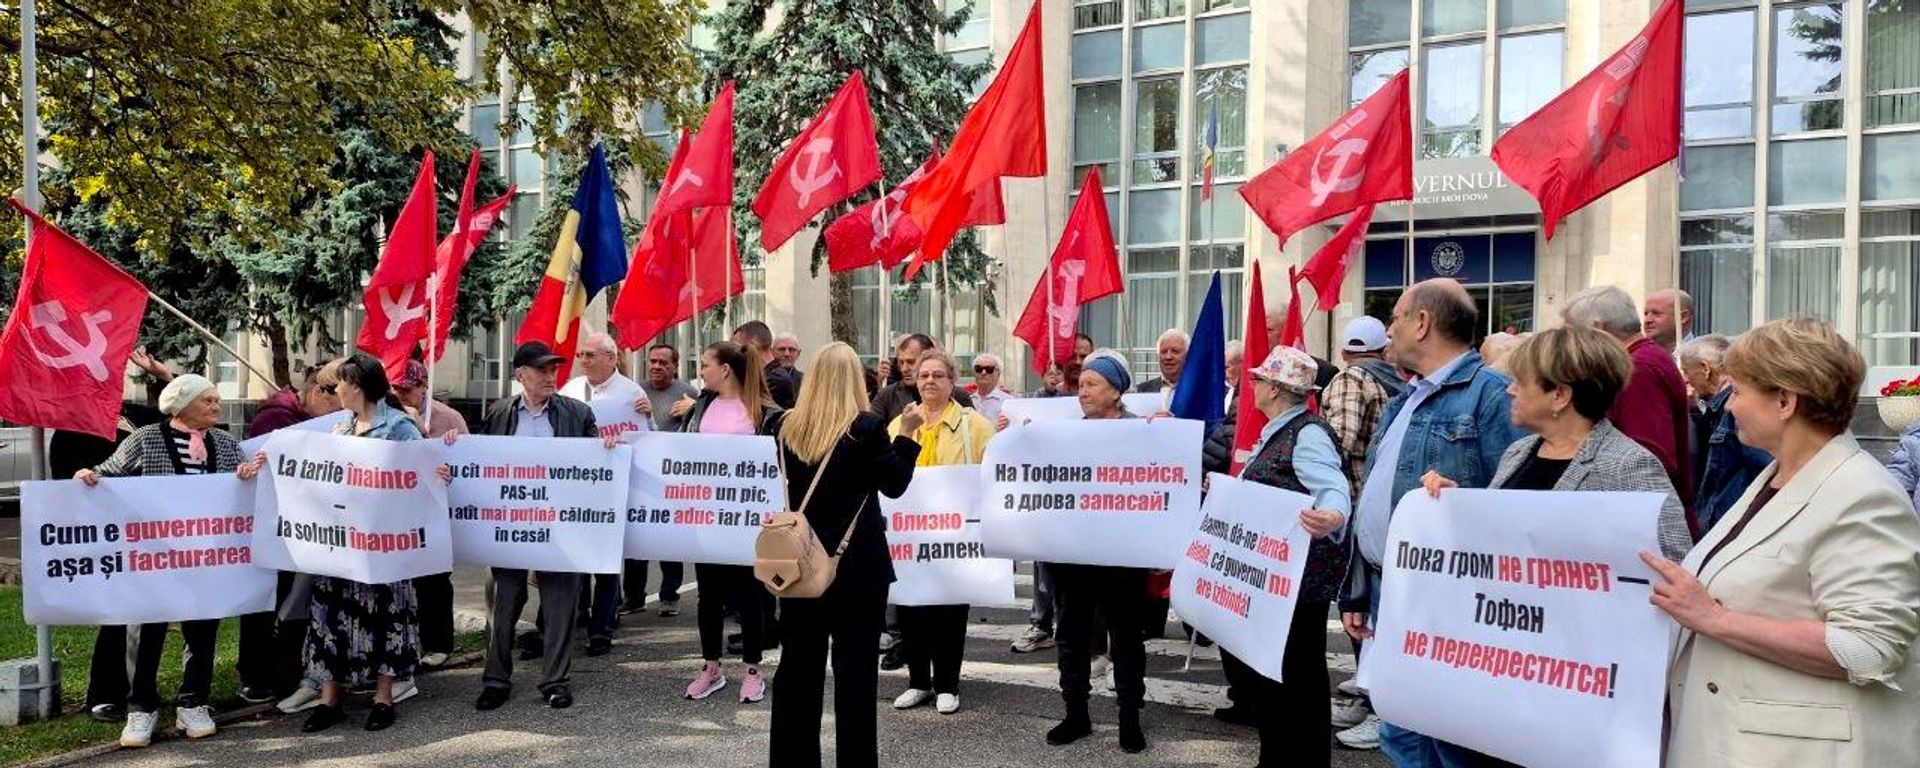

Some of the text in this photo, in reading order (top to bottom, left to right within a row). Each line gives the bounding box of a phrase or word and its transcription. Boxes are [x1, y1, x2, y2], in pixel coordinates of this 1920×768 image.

[1413, 168, 1507, 193] VERNUL
[1442, 193, 1488, 203] MOLDOVA
[278, 454, 418, 489] La tarife înainte
[462, 462, 480, 479] cît
[483, 464, 509, 479] mai
[513, 464, 546, 480] mult
[550, 466, 613, 484] vorbește
[662, 458, 778, 479] Doamne, dă-le
[995, 462, 1188, 486] На Тофана надейся,
[500, 485, 549, 501] PAS-ul,
[664, 483, 769, 504] minte un pic,
[1004, 491, 1170, 512] а дрова запасай!
[455, 504, 478, 520] atît
[481, 506, 507, 521] mai
[510, 507, 556, 524] puțină
[559, 506, 615, 523] căldură
[628, 506, 647, 523] că
[650, 508, 670, 523] ne
[674, 508, 714, 526] aduc
[718, 509, 741, 526] iar
[744, 510, 760, 526] la
[892, 511, 961, 532] близко
[40, 516, 254, 546] Cum e guvernarea
[277, 516, 426, 553] la soluții înapoi!
[495, 527, 550, 542] în casă!
[1230, 523, 1258, 550] dă-ne
[1256, 531, 1289, 562] iarnă
[890, 543, 912, 560] ия
[47, 546, 250, 582] așa și facturarea
[1211, 550, 1226, 571] că
[1223, 557, 1268, 590] guvernul
[1269, 574, 1291, 598] nu
[1396, 540, 1445, 573] Пока
[1448, 549, 1494, 580] гром
[1498, 555, 1522, 583] не
[1527, 557, 1610, 592] грянет
[1196, 577, 1251, 618] are izbîndă!
[1475, 592, 1544, 634] Тофан
[1404, 630, 1618, 699] не перекрестится!
